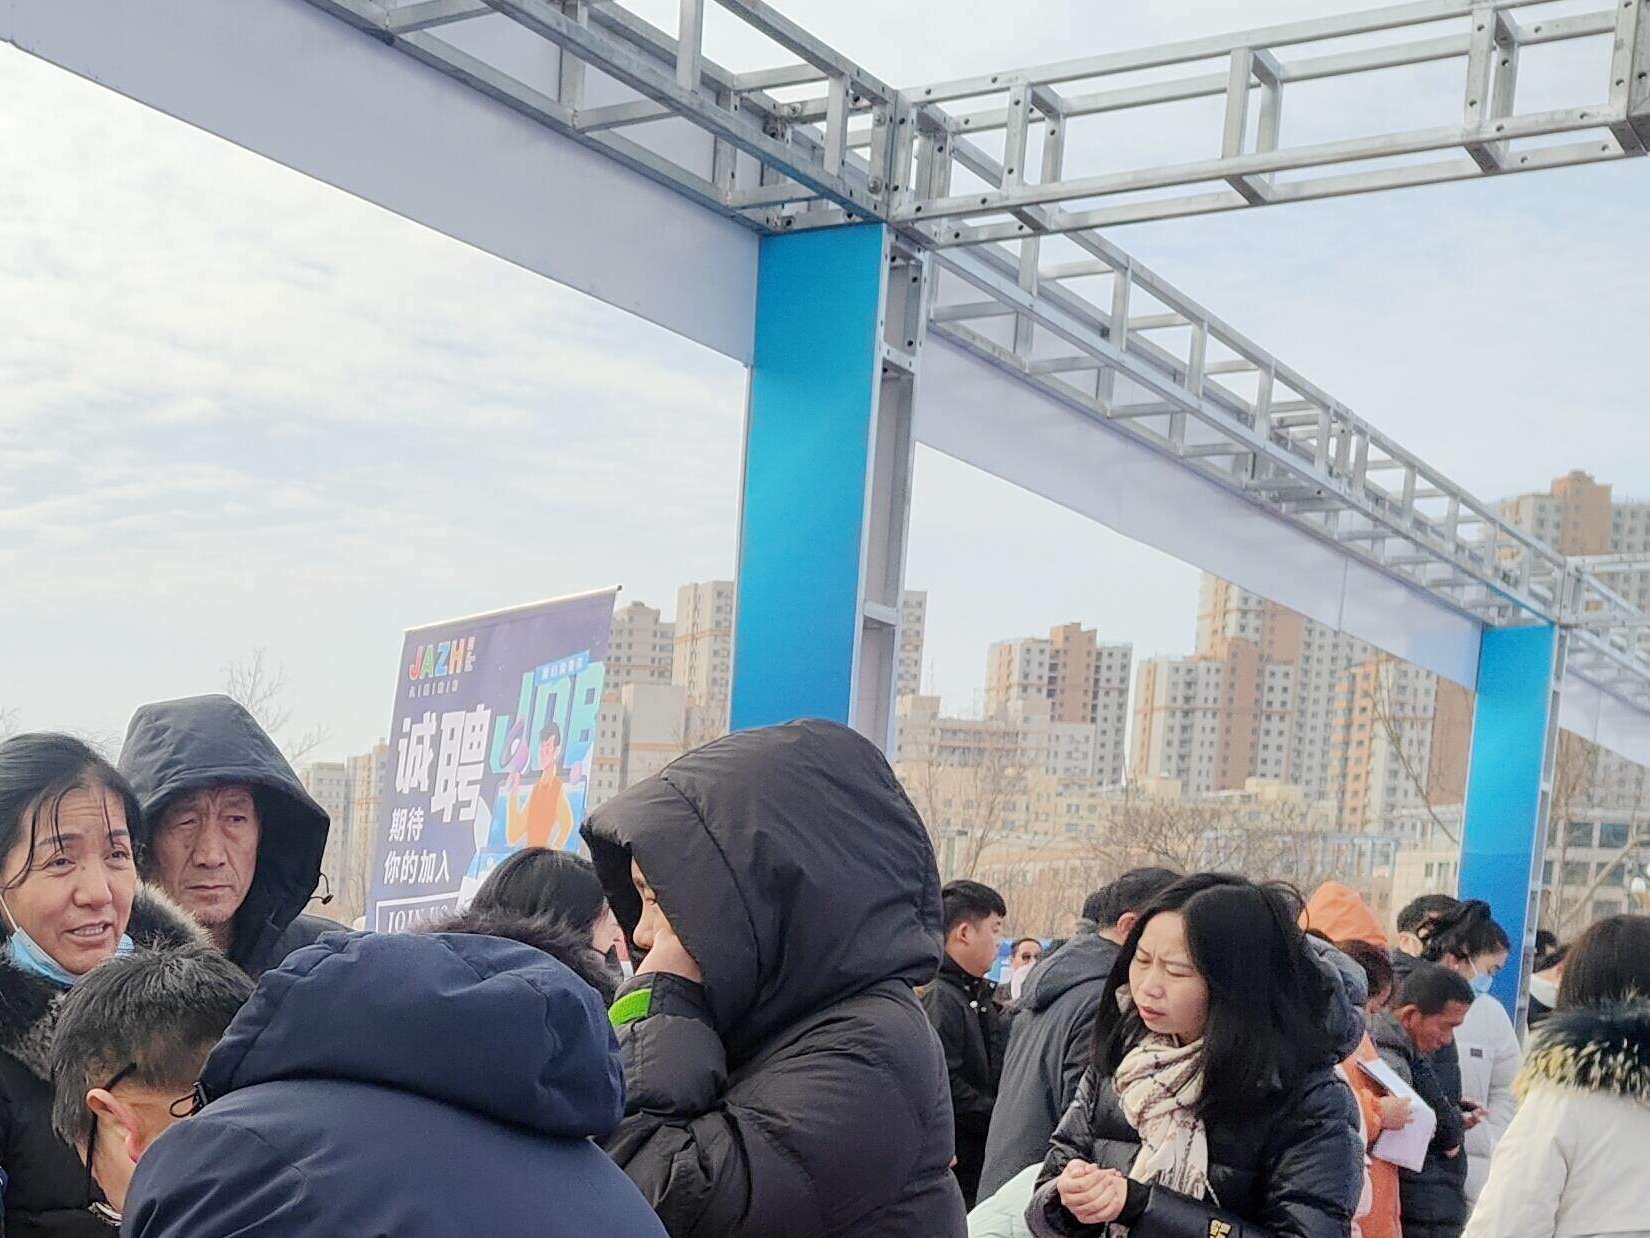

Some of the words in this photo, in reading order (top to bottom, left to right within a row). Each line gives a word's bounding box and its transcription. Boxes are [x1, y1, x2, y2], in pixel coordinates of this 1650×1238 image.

[490, 660, 605, 774] JOB
[395, 703, 491, 823] 诚聘
[388, 806, 425, 842] 期待
[383, 849, 450, 885] 你的加入
